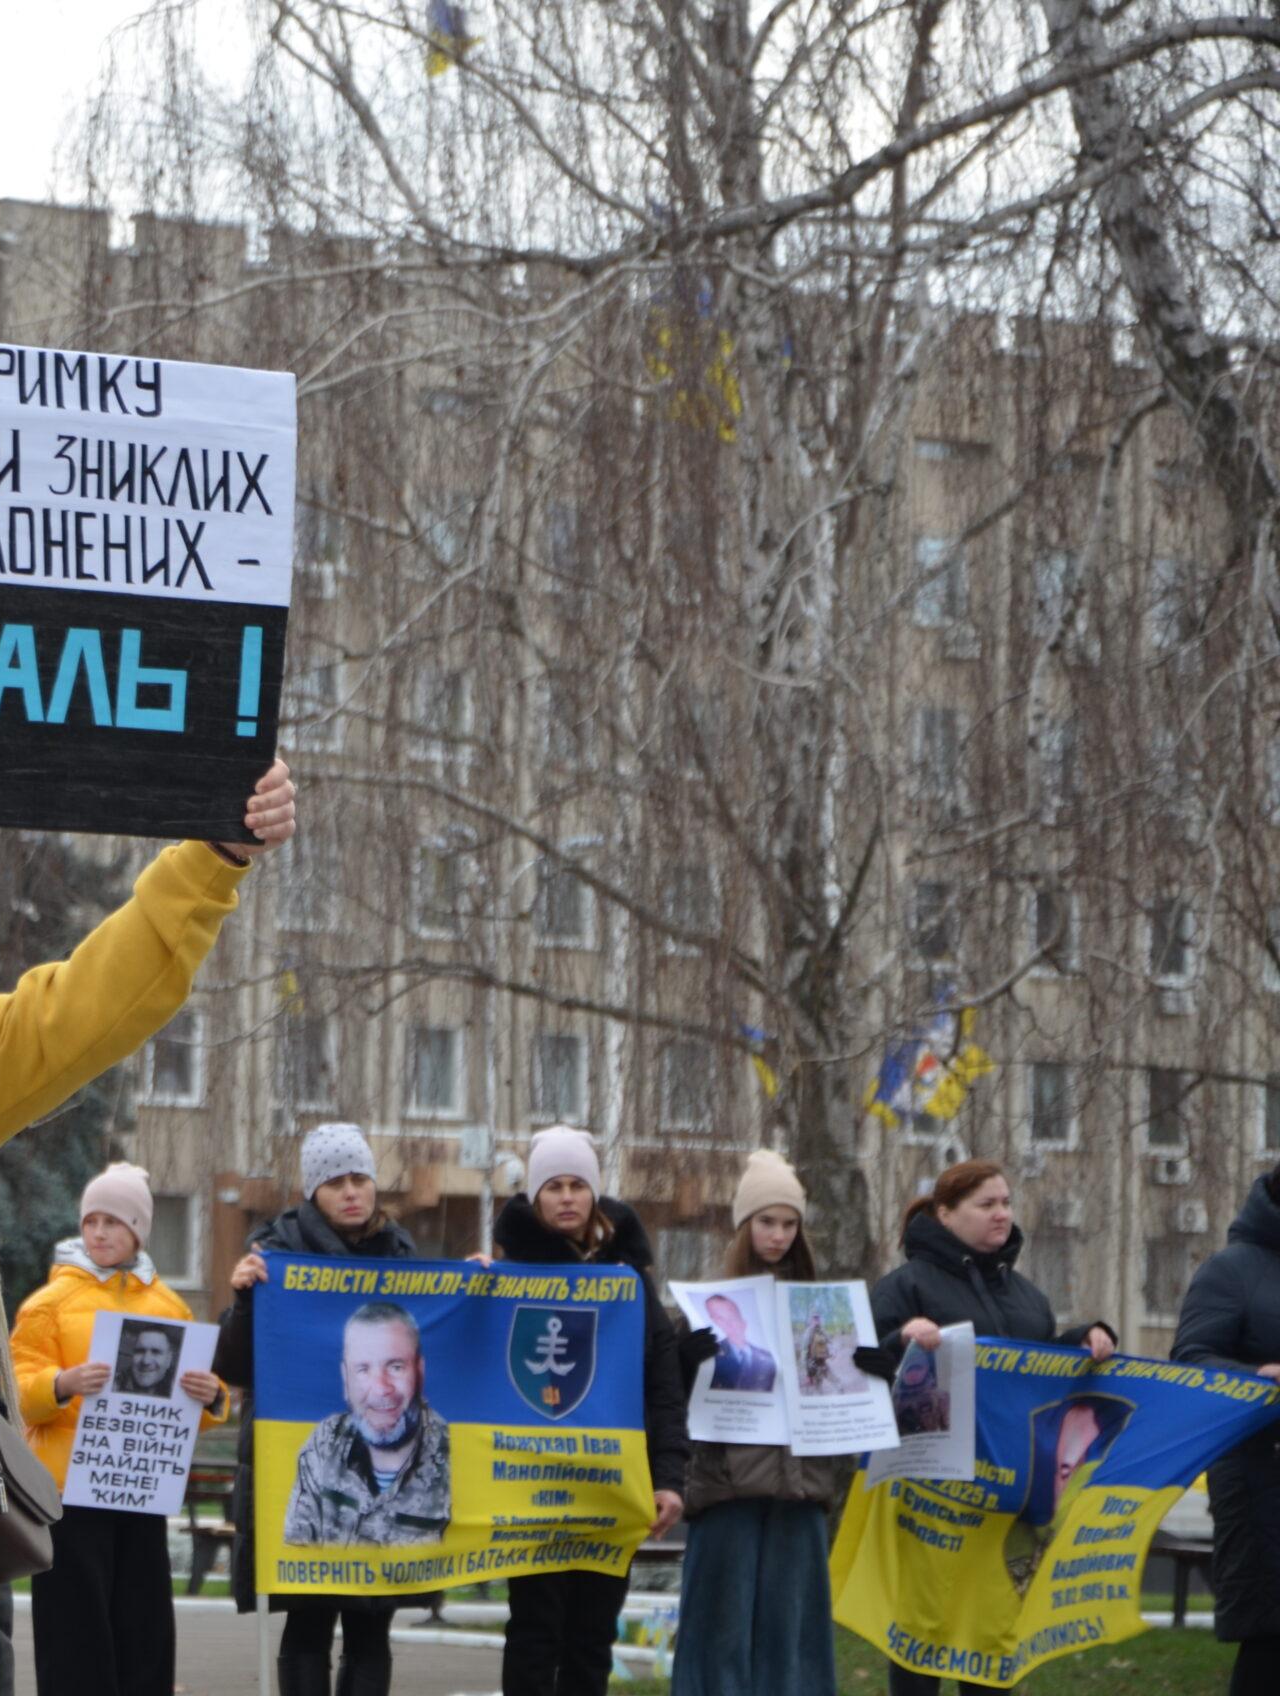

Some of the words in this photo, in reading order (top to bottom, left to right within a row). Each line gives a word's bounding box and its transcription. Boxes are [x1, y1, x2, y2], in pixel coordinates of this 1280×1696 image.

[49, 434, 273, 516] ЗНИКЛИХ
[284, 1265, 379, 1293] БЕЗВІСТИ
[492, 1274, 569, 1300] ЗНАЧИТЬ
[572, 1277, 638, 1302] ЗАБУТІ
[1116, 1361, 1205, 1388] ЗНАЧИТЬ
[95, 1400, 108, 1412] Я
[120, 1401, 183, 1422] ЗНИК
[82, 1415, 190, 1441] БЕЗВІСТИ
[81, 1434, 110, 1449] НА
[123, 1435, 182, 1457] ВІЙНІ
[72, 1451, 186, 1476] ЗНАЙДІТЬ
[89, 1471, 159, 1491] МЕНЕ!
[278, 1560, 375, 1584] ПОВЕРНІТЬ
[381, 1554, 454, 1584] ЧОЛОВІКА
[467, 1548, 528, 1573] БАТЬКА
[532, 1540, 623, 1566] ДОДОМУ!
[887, 1620, 991, 1678] ЧЕКАЄМО!
